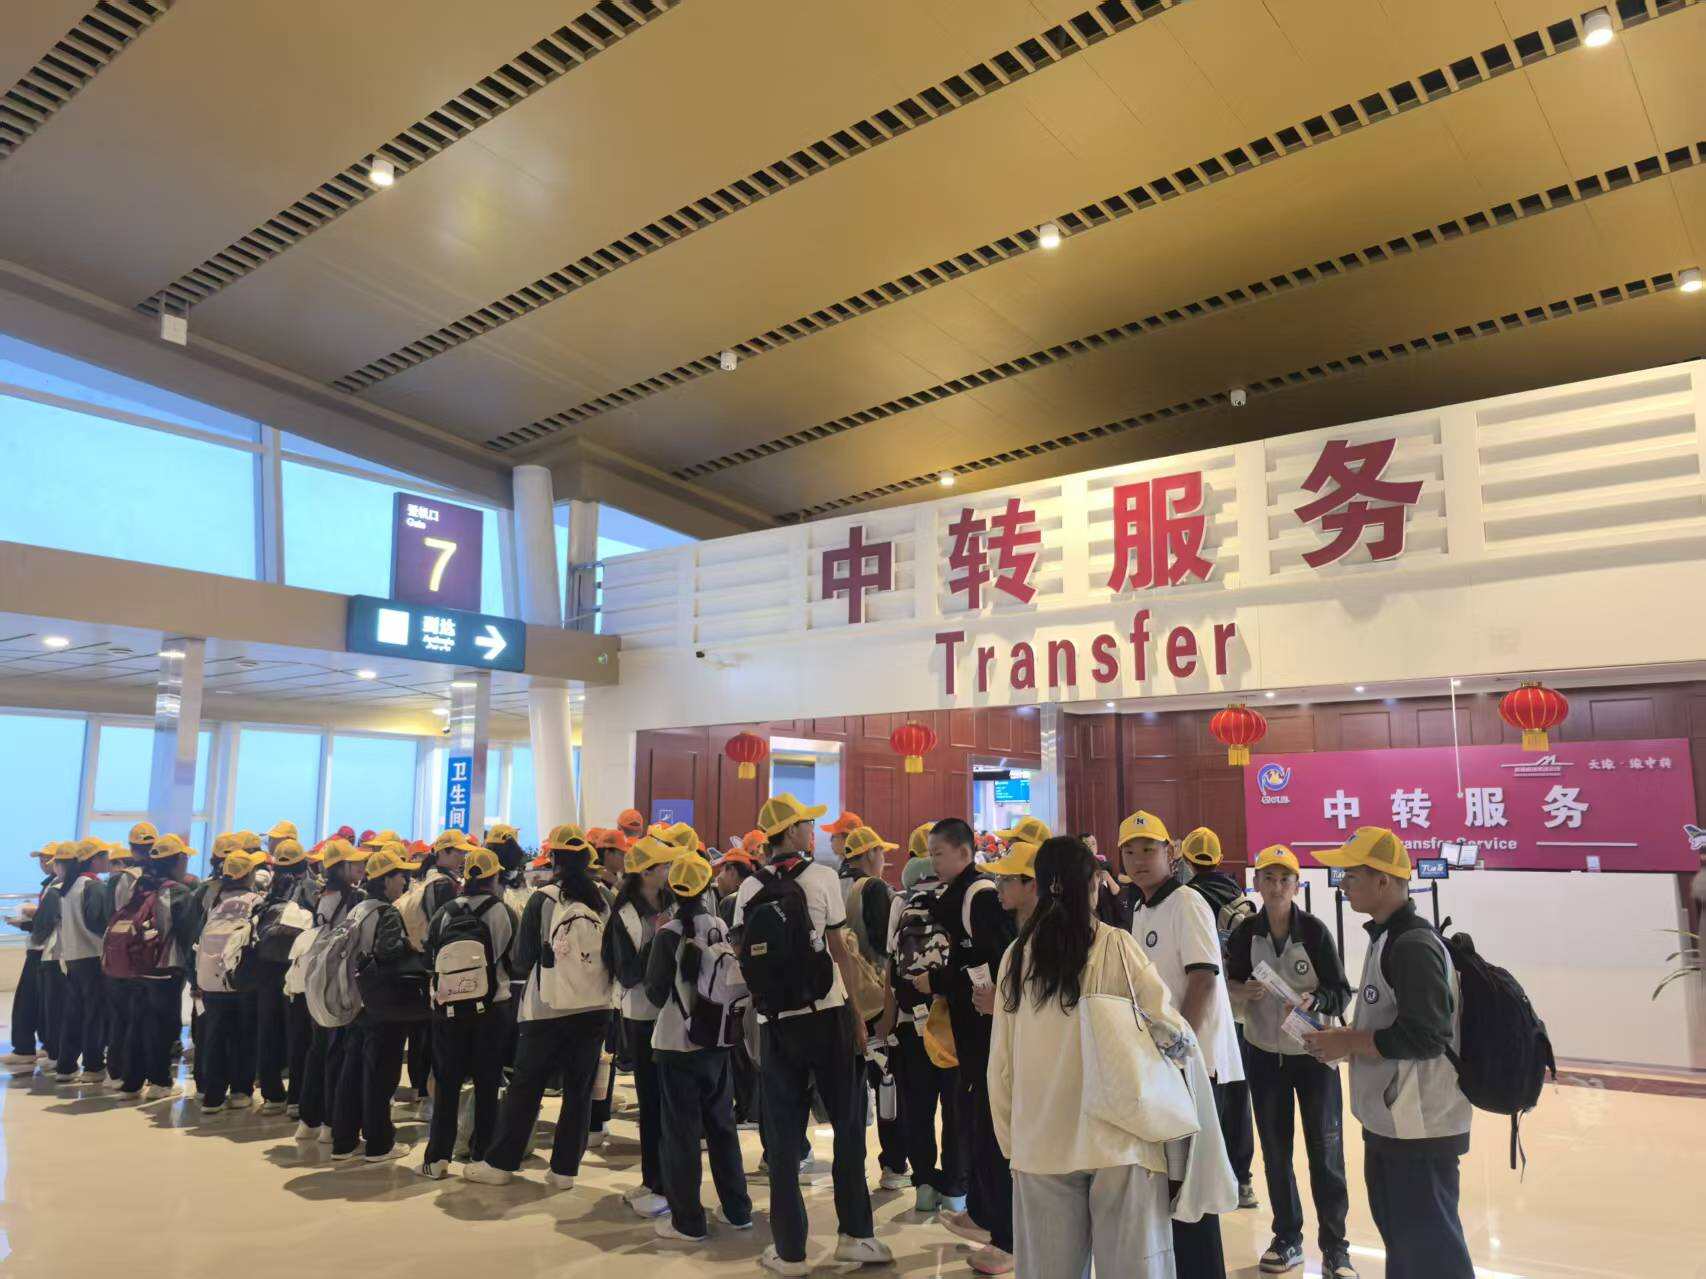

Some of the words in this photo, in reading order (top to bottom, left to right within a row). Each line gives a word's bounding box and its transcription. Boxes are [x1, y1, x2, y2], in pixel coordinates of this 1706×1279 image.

[424, 537, 457, 592] 7
[822, 437, 1424, 625] 中转服务
[936, 609, 1237, 695] Transfer
[449, 761, 467, 829] 卫生间
[1323, 784, 1589, 829] 中转服务
